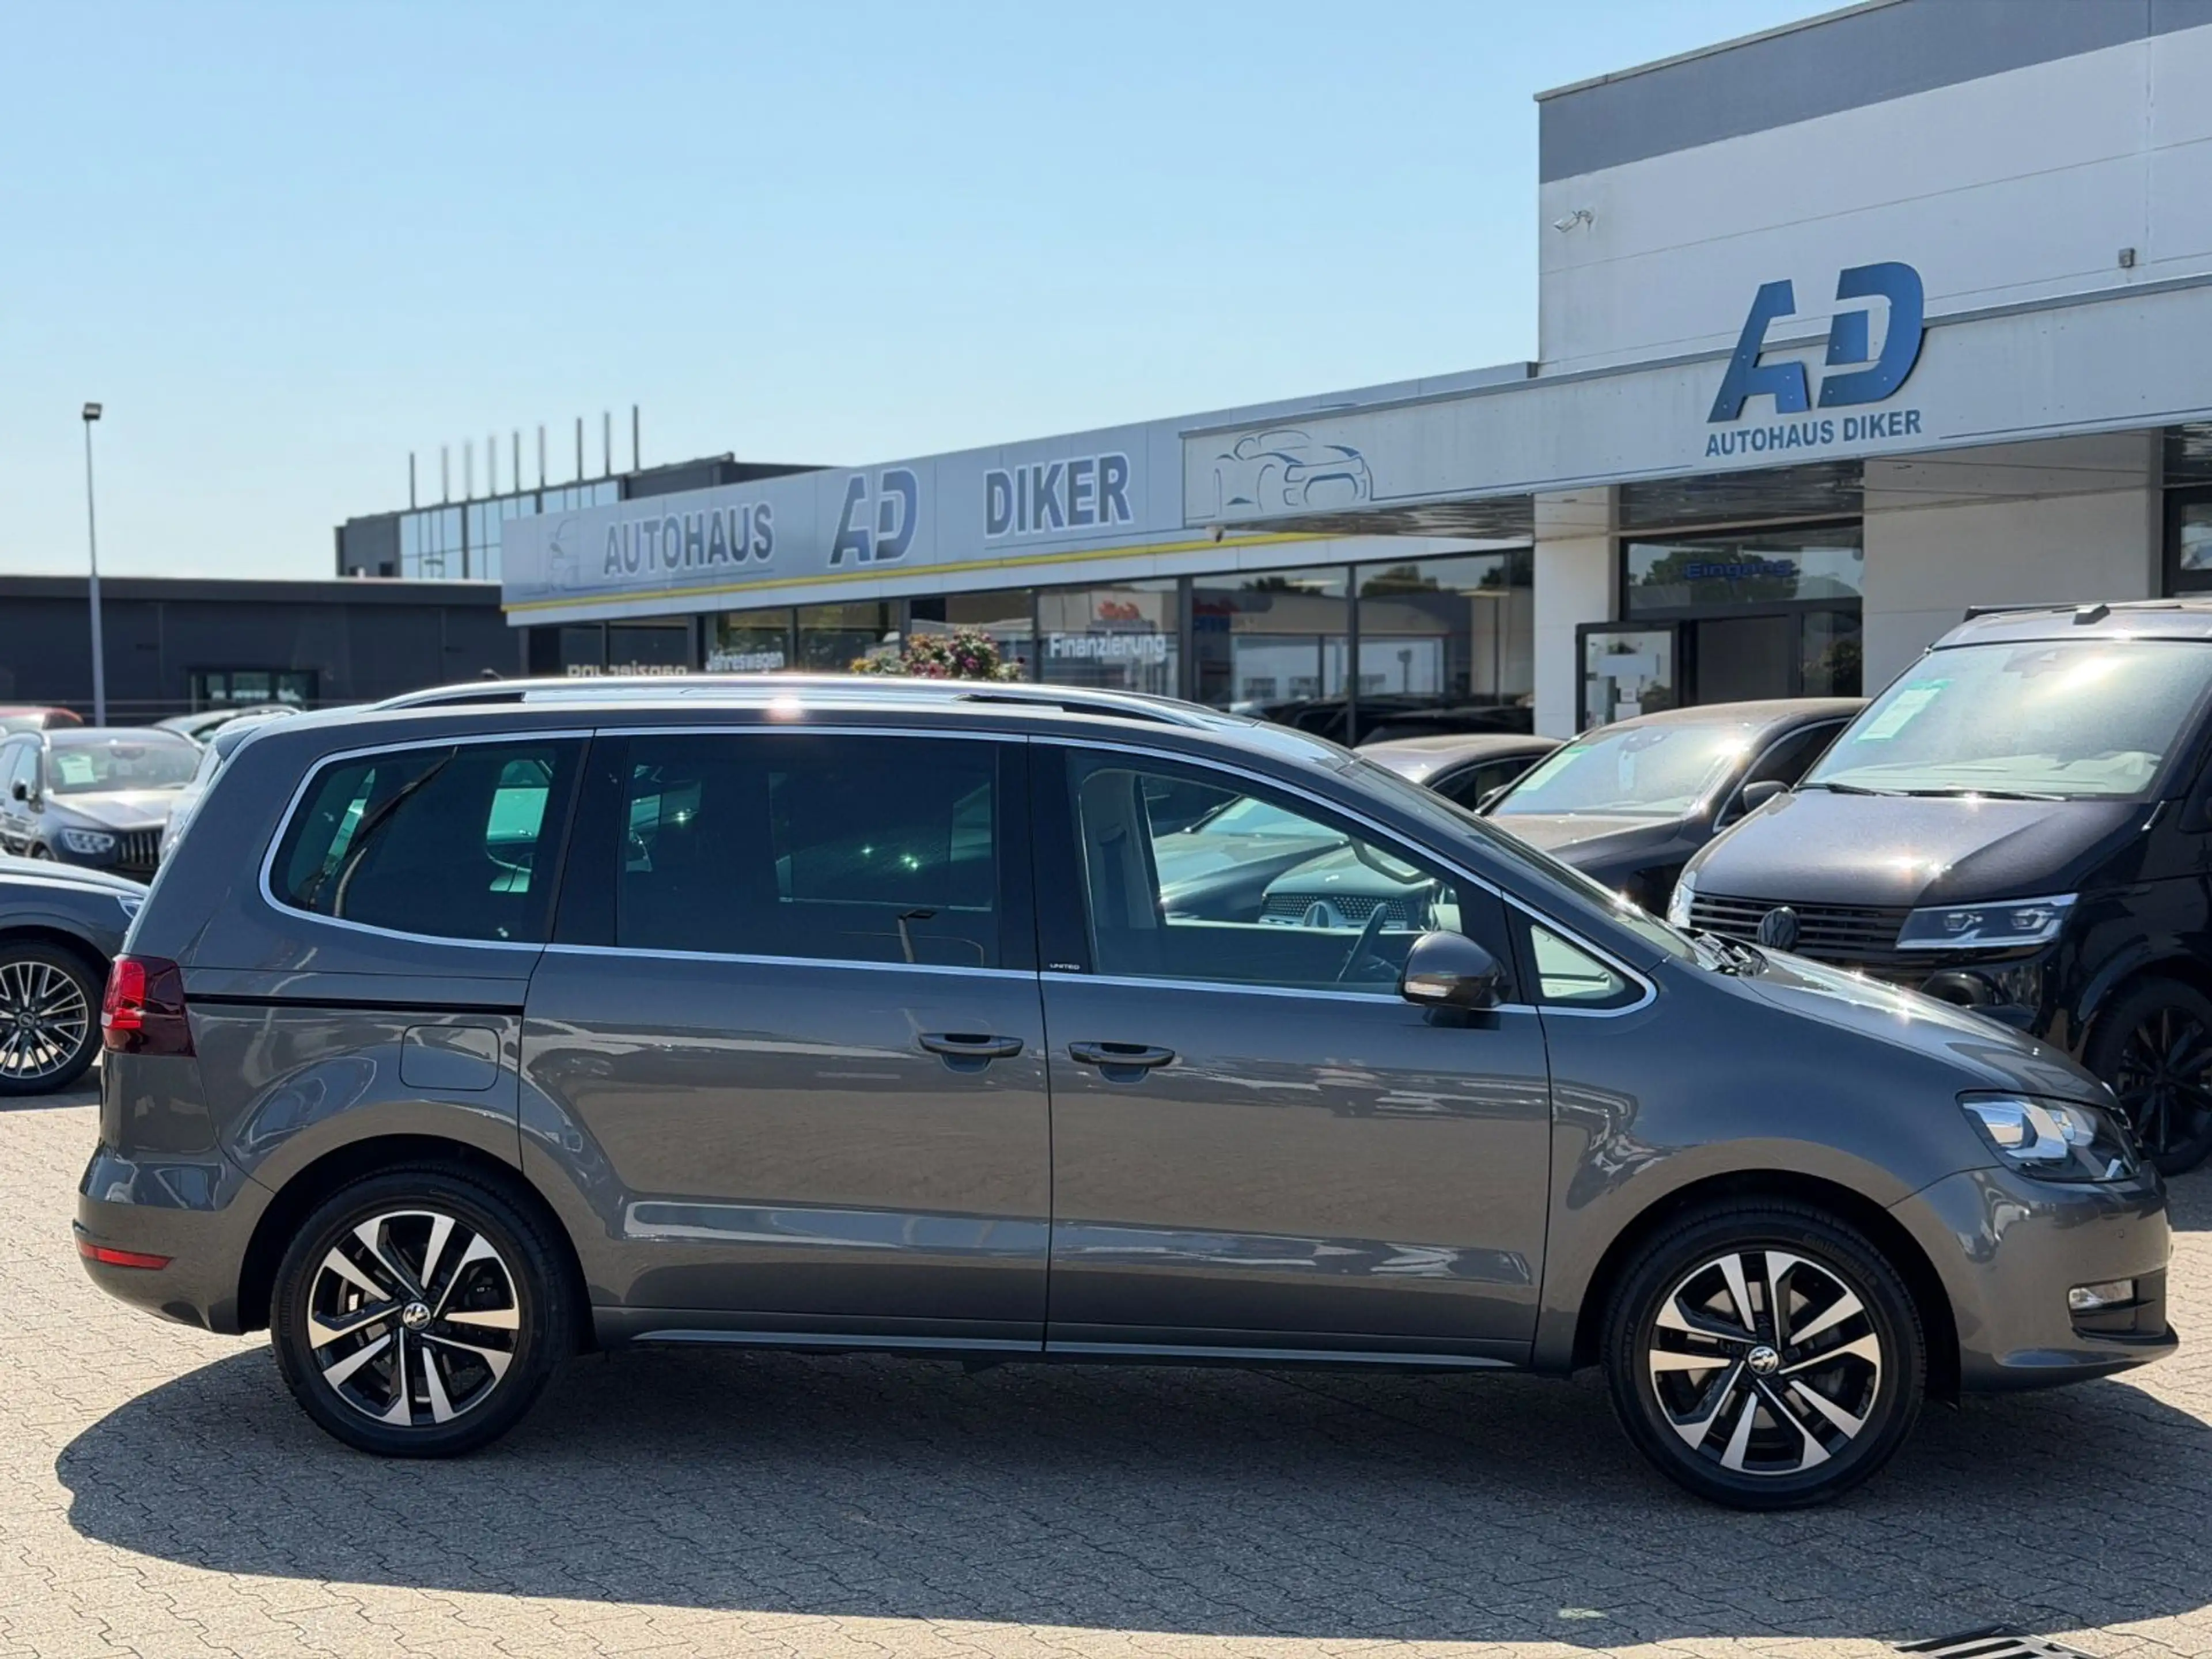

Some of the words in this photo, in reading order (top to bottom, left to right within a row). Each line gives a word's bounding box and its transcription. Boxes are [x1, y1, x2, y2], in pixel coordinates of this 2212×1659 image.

[1707, 261, 1925, 423] AD
[1705, 421, 1834, 457] AUTOHAUS
[1842, 408, 1922, 443] DIKER
[603, 501, 774, 579] AUTOHAUS
[828, 467, 918, 568] AD
[984, 452, 1134, 539] DIKER
[704, 650, 785, 675] Jahreswagen
[1048, 631, 1166, 663] Finanzierung
